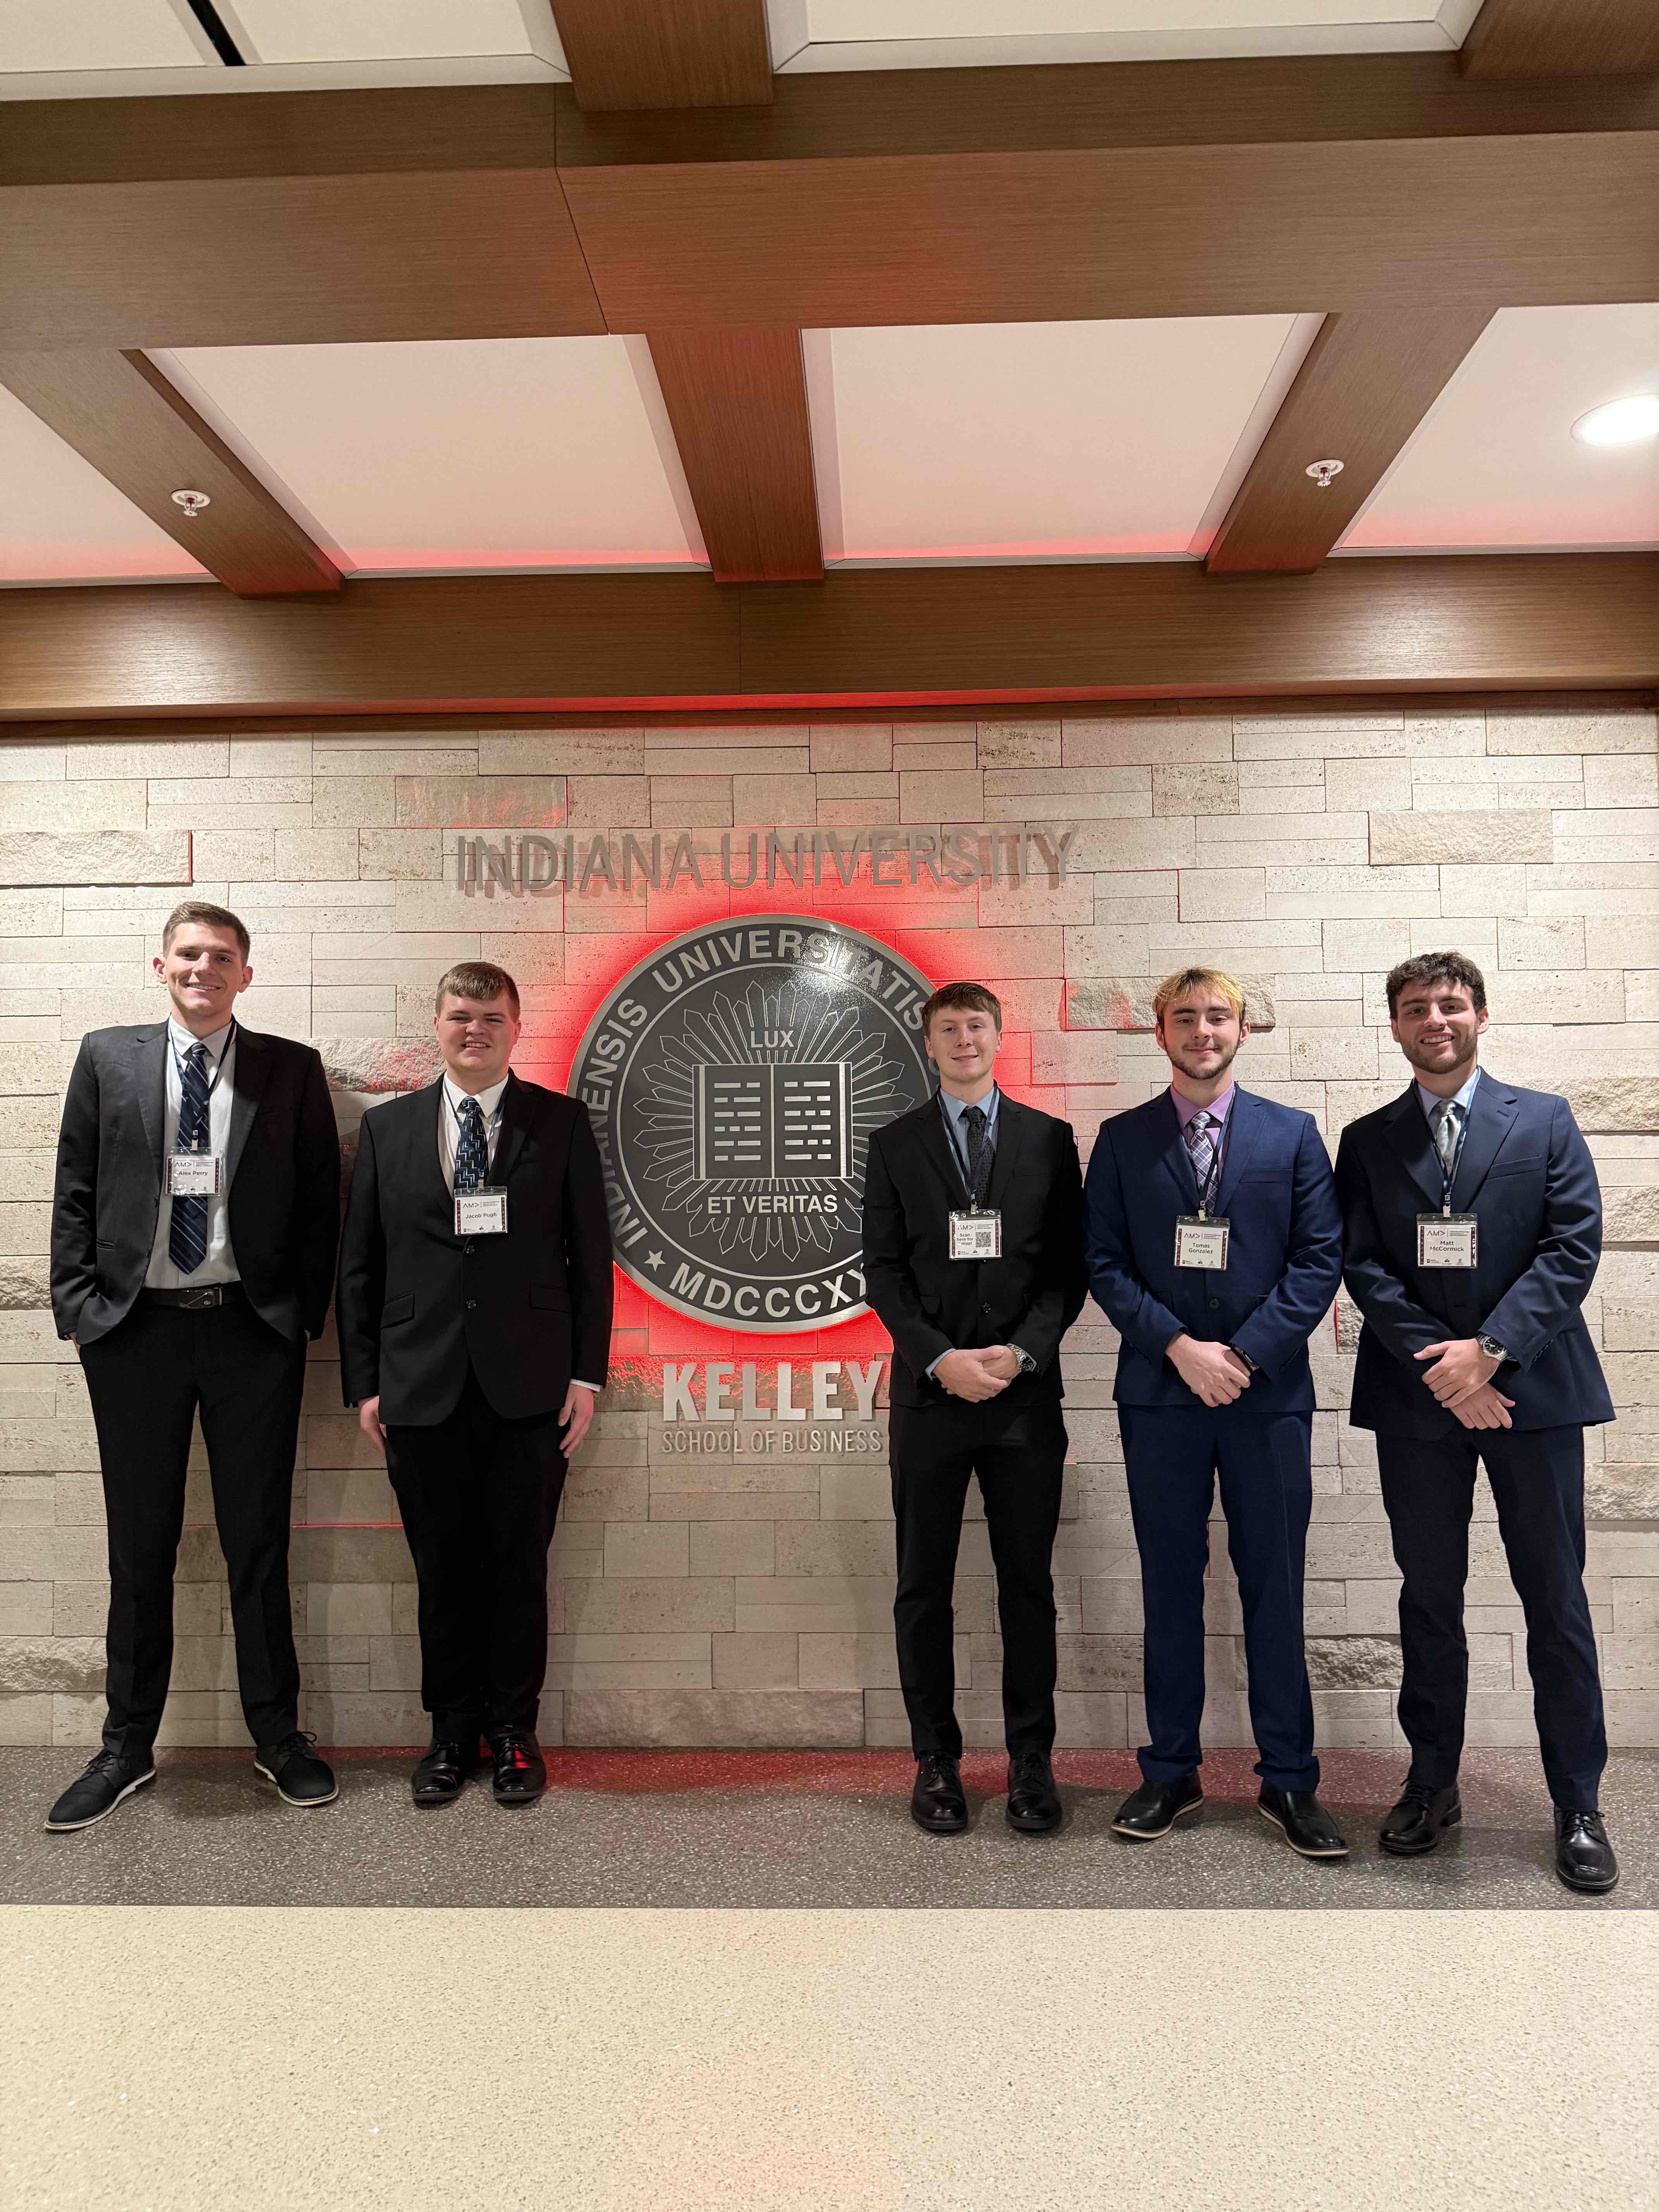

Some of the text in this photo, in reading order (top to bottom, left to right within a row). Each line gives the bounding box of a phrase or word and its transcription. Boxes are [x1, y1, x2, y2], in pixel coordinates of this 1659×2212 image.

[458, 825, 1080, 891] INDIANA UNIVERSITY
[652, 929, 926, 1030] UNIVERSITATIS
[750, 1030, 794, 1048] LUX
[708, 1194, 838, 1214] ET VERITAS
[663, 1361, 883, 1421] KELLEY
[662, 1429, 881, 1453] SCHOOL OF BUSINESS
